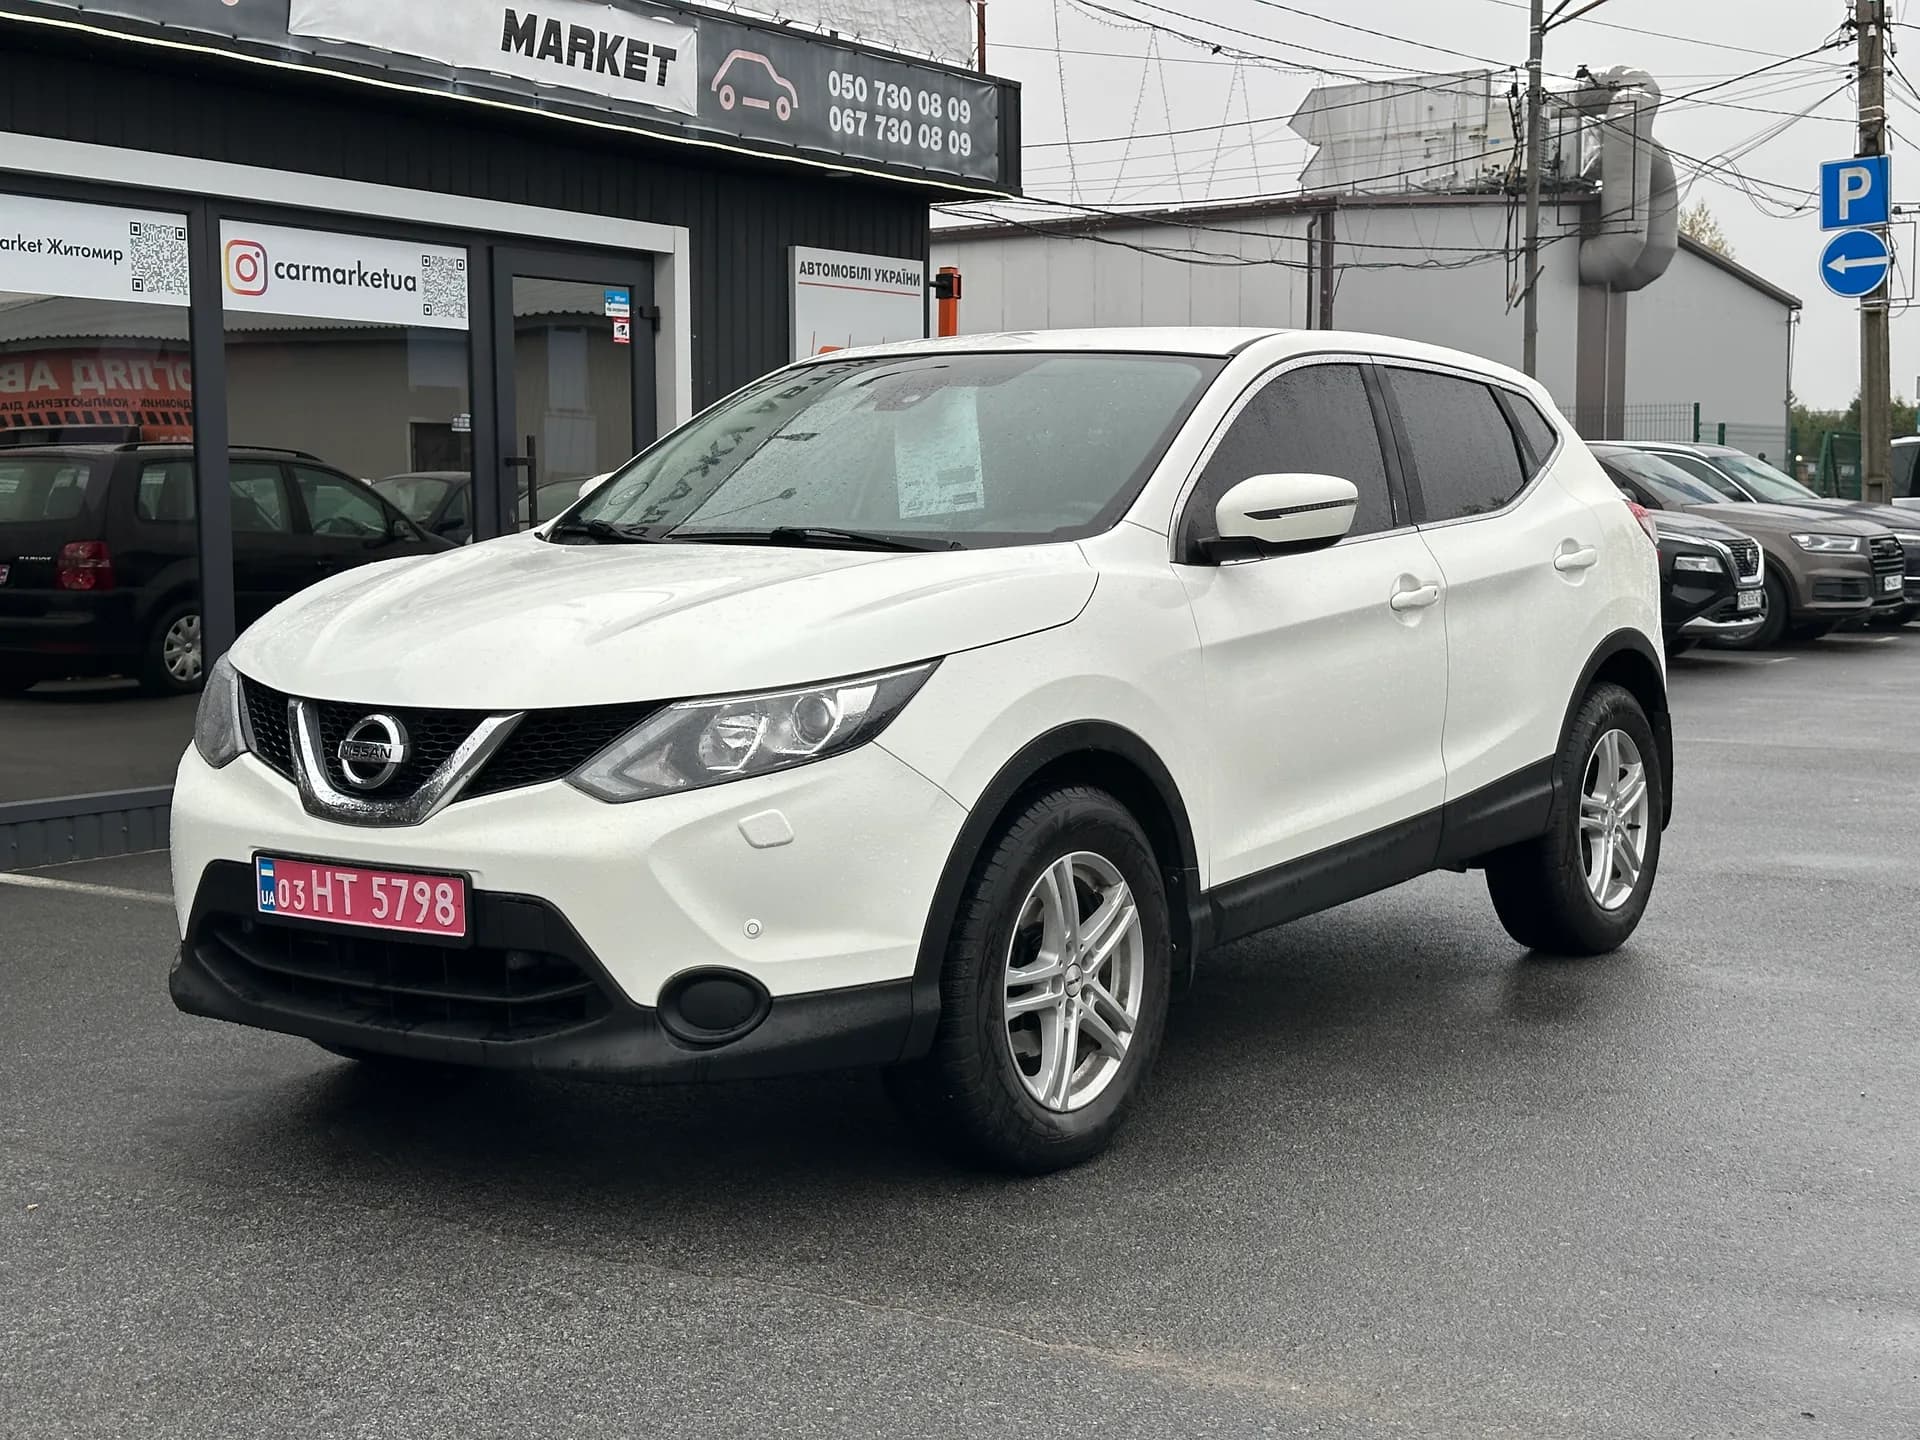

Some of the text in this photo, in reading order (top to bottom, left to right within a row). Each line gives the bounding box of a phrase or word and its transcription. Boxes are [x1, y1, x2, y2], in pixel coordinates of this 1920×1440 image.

[501, 8, 677, 87] MARKET
[828, 70, 971, 124] 050 730 08 09
[829, 105, 971, 157] 067 730 08 09
[1839, 166, 1871, 220] P
[47, 238, 123, 265] Житомир
[274, 260, 417, 292] carmarketua
[799, 261, 920, 287] АВТОМОБІЛІ УКРАЇНИ
[342, 742, 392, 759] NISSAN
[261, 890, 276, 906] UA
[371, 877, 455, 926] 5798
